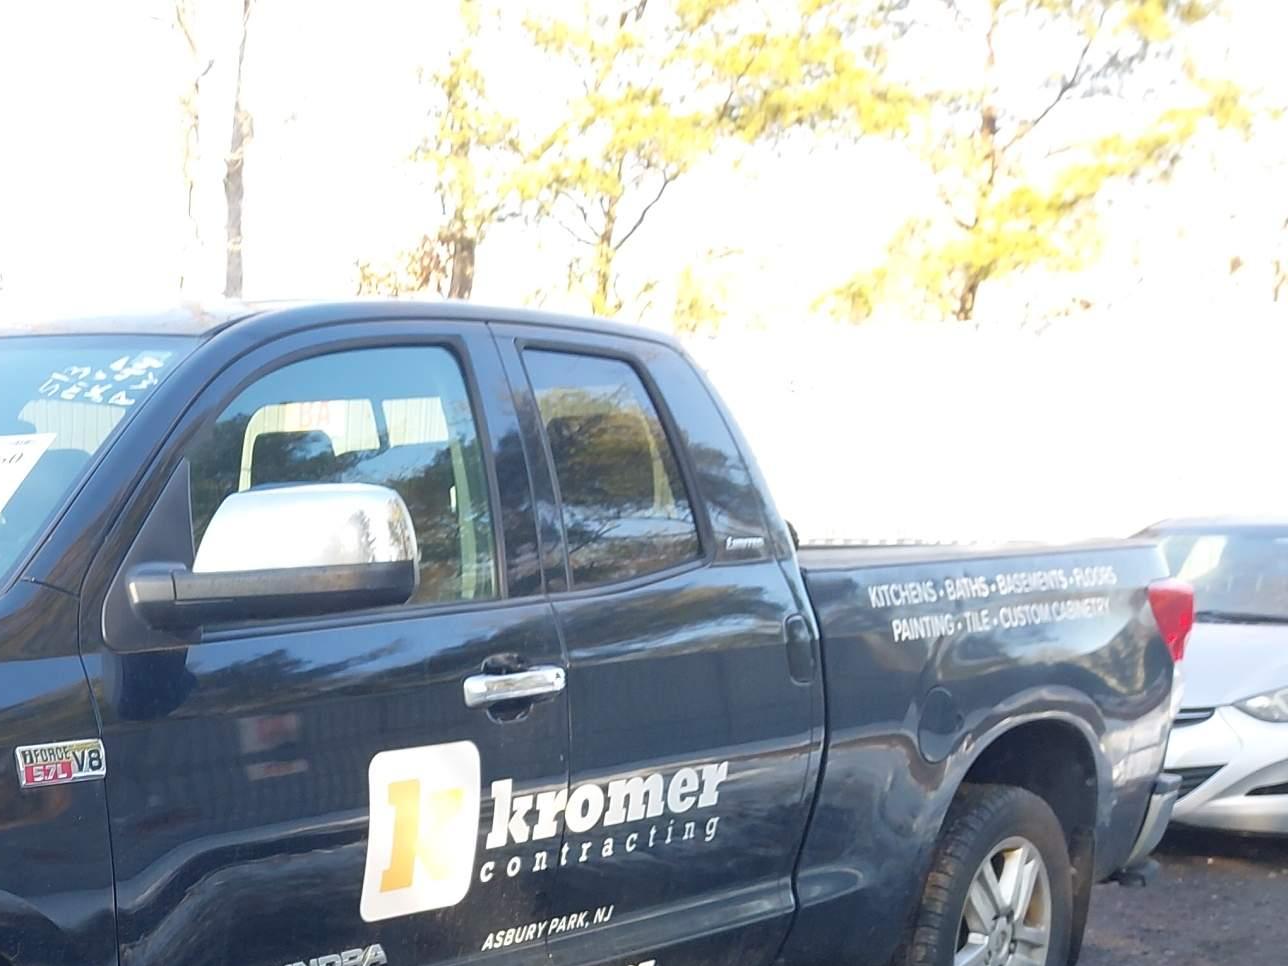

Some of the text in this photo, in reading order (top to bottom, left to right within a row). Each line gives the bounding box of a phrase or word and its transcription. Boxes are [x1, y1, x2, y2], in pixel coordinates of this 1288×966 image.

[868, 566, 1118, 609] KITCHENS BATHS BASEMENTS FLOORS
[892, 597, 1112, 642] PAINTING TILE CUSTOM CABINETRY
[72, 748, 103, 772] V8
[485, 761, 729, 850] kromer
[479, 816, 721, 883] contracting
[481, 904, 615, 951] ASBURY PARK, NJ
